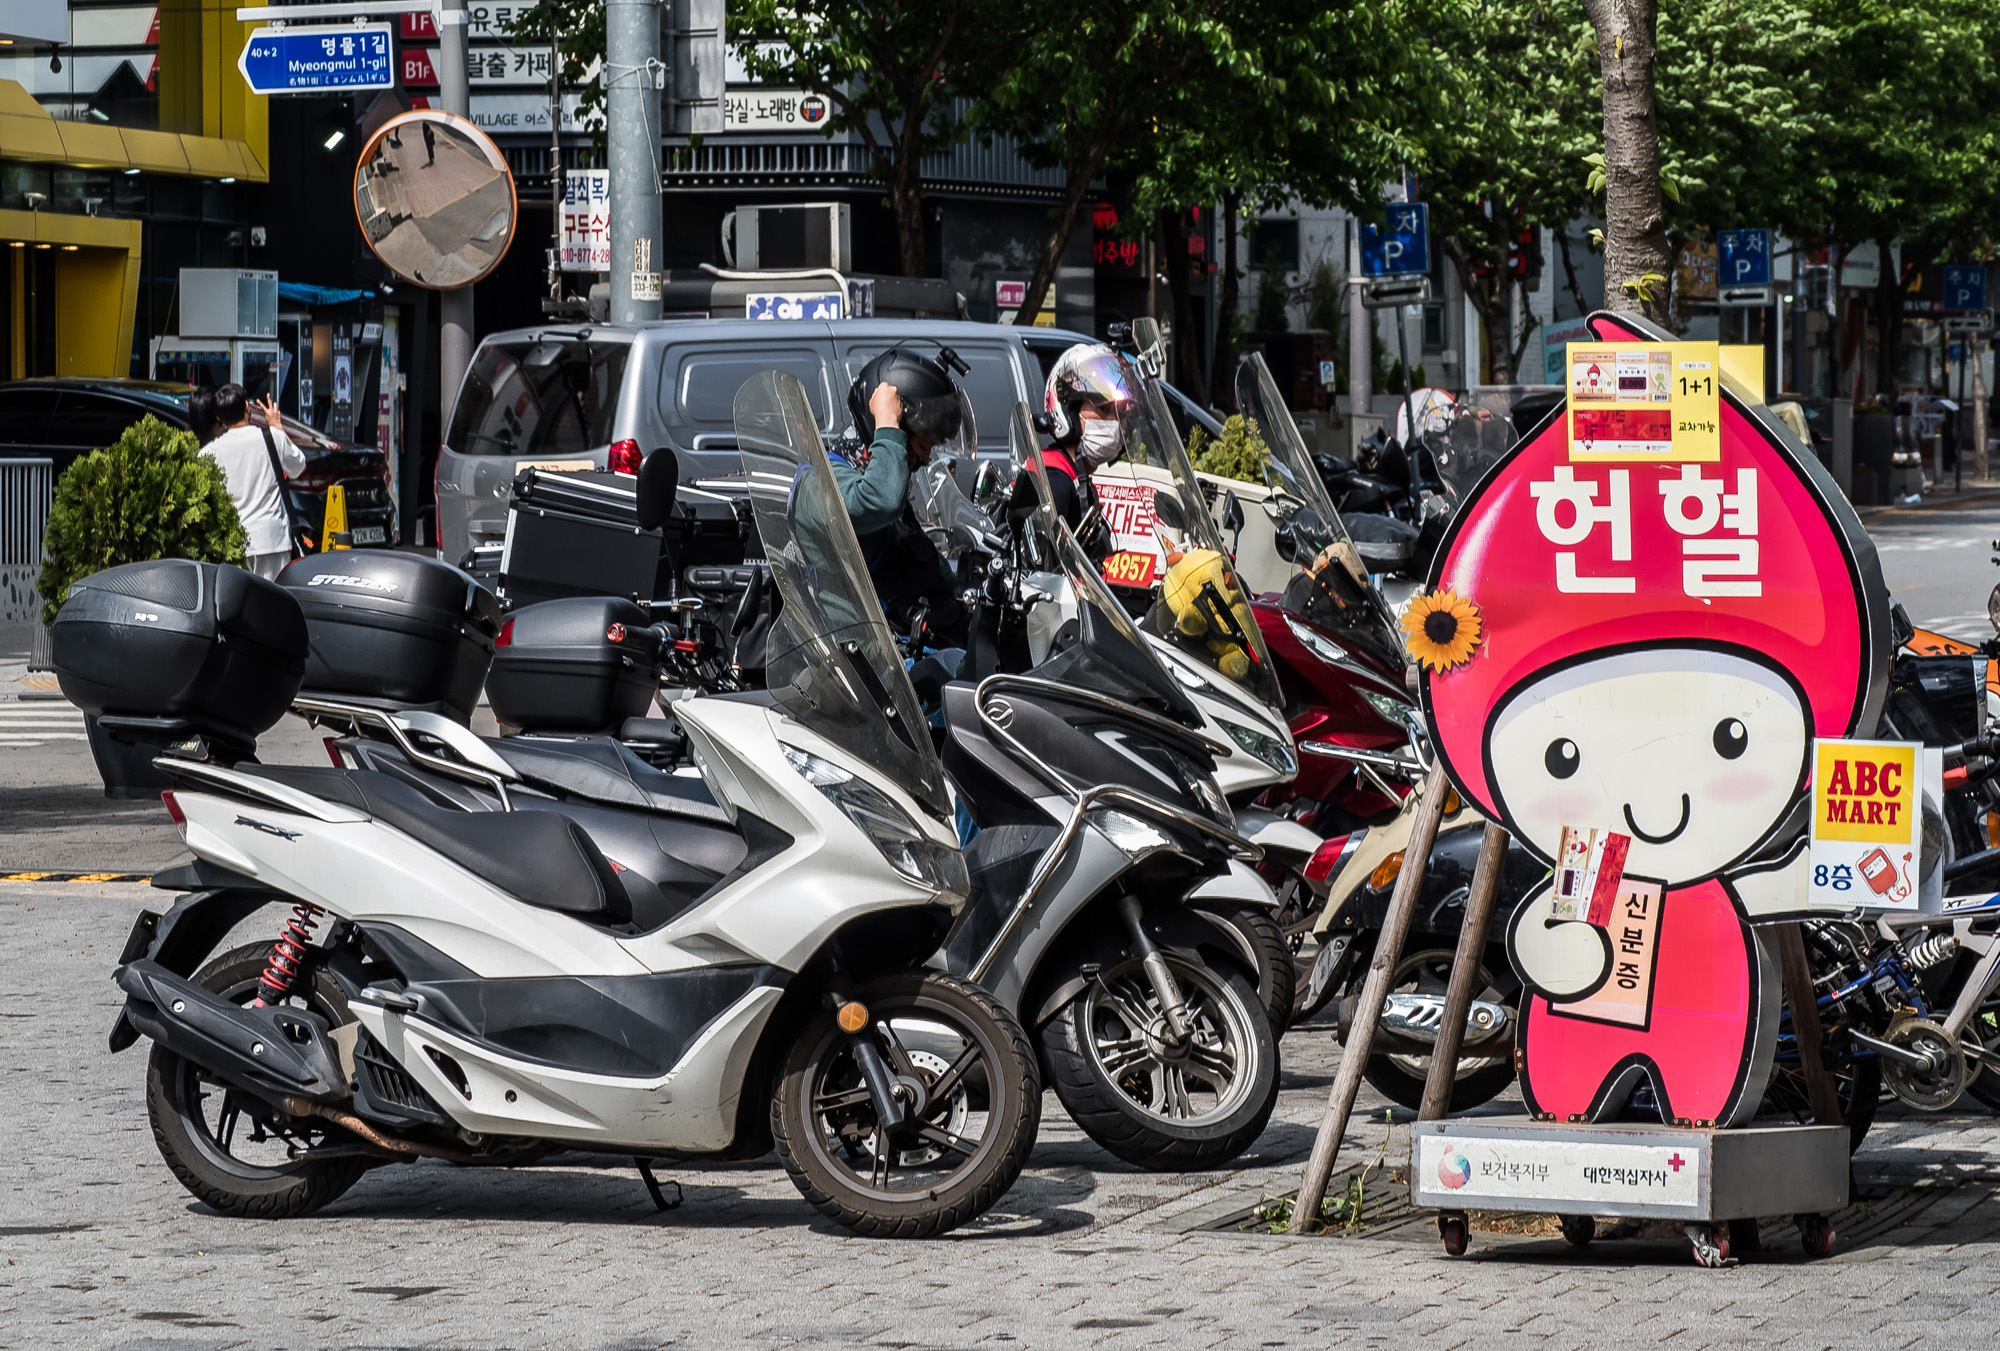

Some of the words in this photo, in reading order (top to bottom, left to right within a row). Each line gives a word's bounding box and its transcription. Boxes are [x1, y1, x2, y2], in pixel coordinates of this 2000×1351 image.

[251, 48, 262, 58] 40
[271, 47, 277, 57] 2
[322, 35, 386, 57] 명물1길
[288, 58, 356, 73] Myeongmul
[361, 56, 387, 70] 1-gil
[405, 61, 430, 79] B1F
[470, 113, 518, 126] VILLAGE
[565, 176, 609, 205] 열쇠복
[1384, 240, 1404, 269] P
[1736, 259, 1752, 282] P
[1958, 289, 1971, 306] P
[1679, 376, 1711, 396] 1+1
[1678, 420, 1716, 434] 교차가능
[1530, 464, 1763, 597] 헌혈
[1827, 759, 1902, 798] ABC
[1826, 798, 1901, 826] MART
[1813, 863, 1854, 891] 8층
[1615, 892, 1649, 990] 신분증
[1480, 1160, 1550, 1183] 보건복지부
[1583, 1166, 1668, 1188] 대한적십자사
